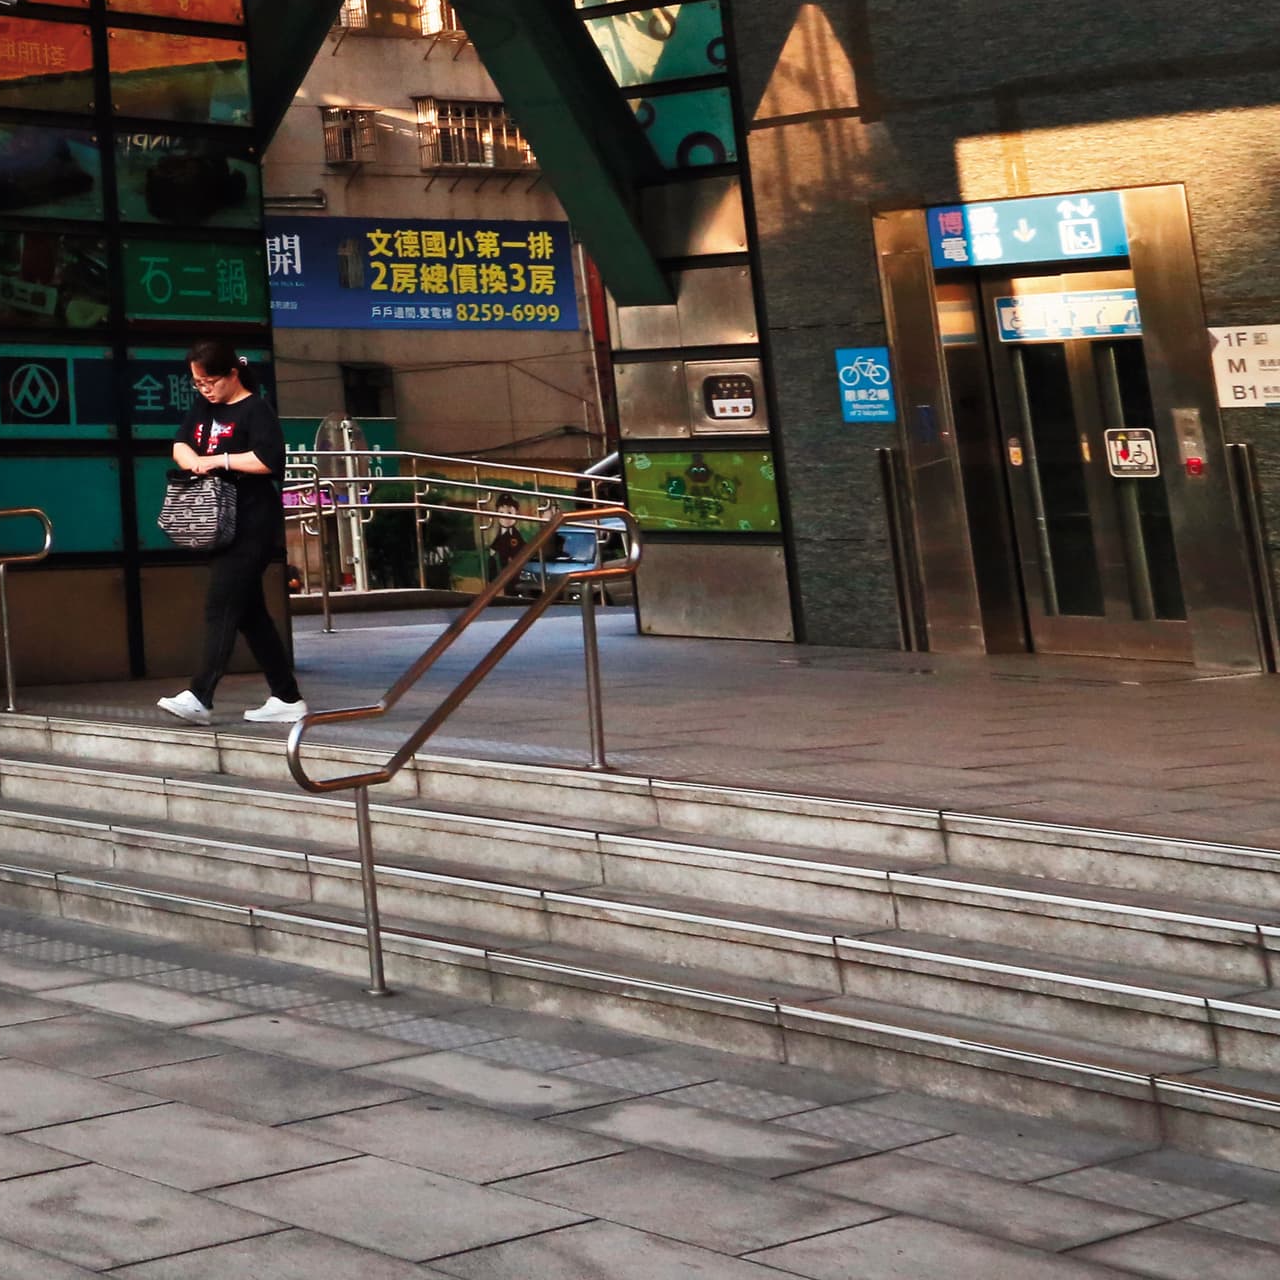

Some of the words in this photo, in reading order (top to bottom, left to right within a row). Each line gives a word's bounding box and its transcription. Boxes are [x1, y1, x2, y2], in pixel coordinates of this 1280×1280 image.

[266, 234, 302, 276] 開
[367, 228, 554, 259] 文德國小第一排
[139, 256, 248, 305] 石二鍋
[370, 261, 557, 295] 2房總價換3房
[456, 304, 560, 322] 8259-6999
[1224, 332, 1247, 347] 1F
[1227, 358, 1247, 373] M
[1232, 384, 1258, 400] B1
